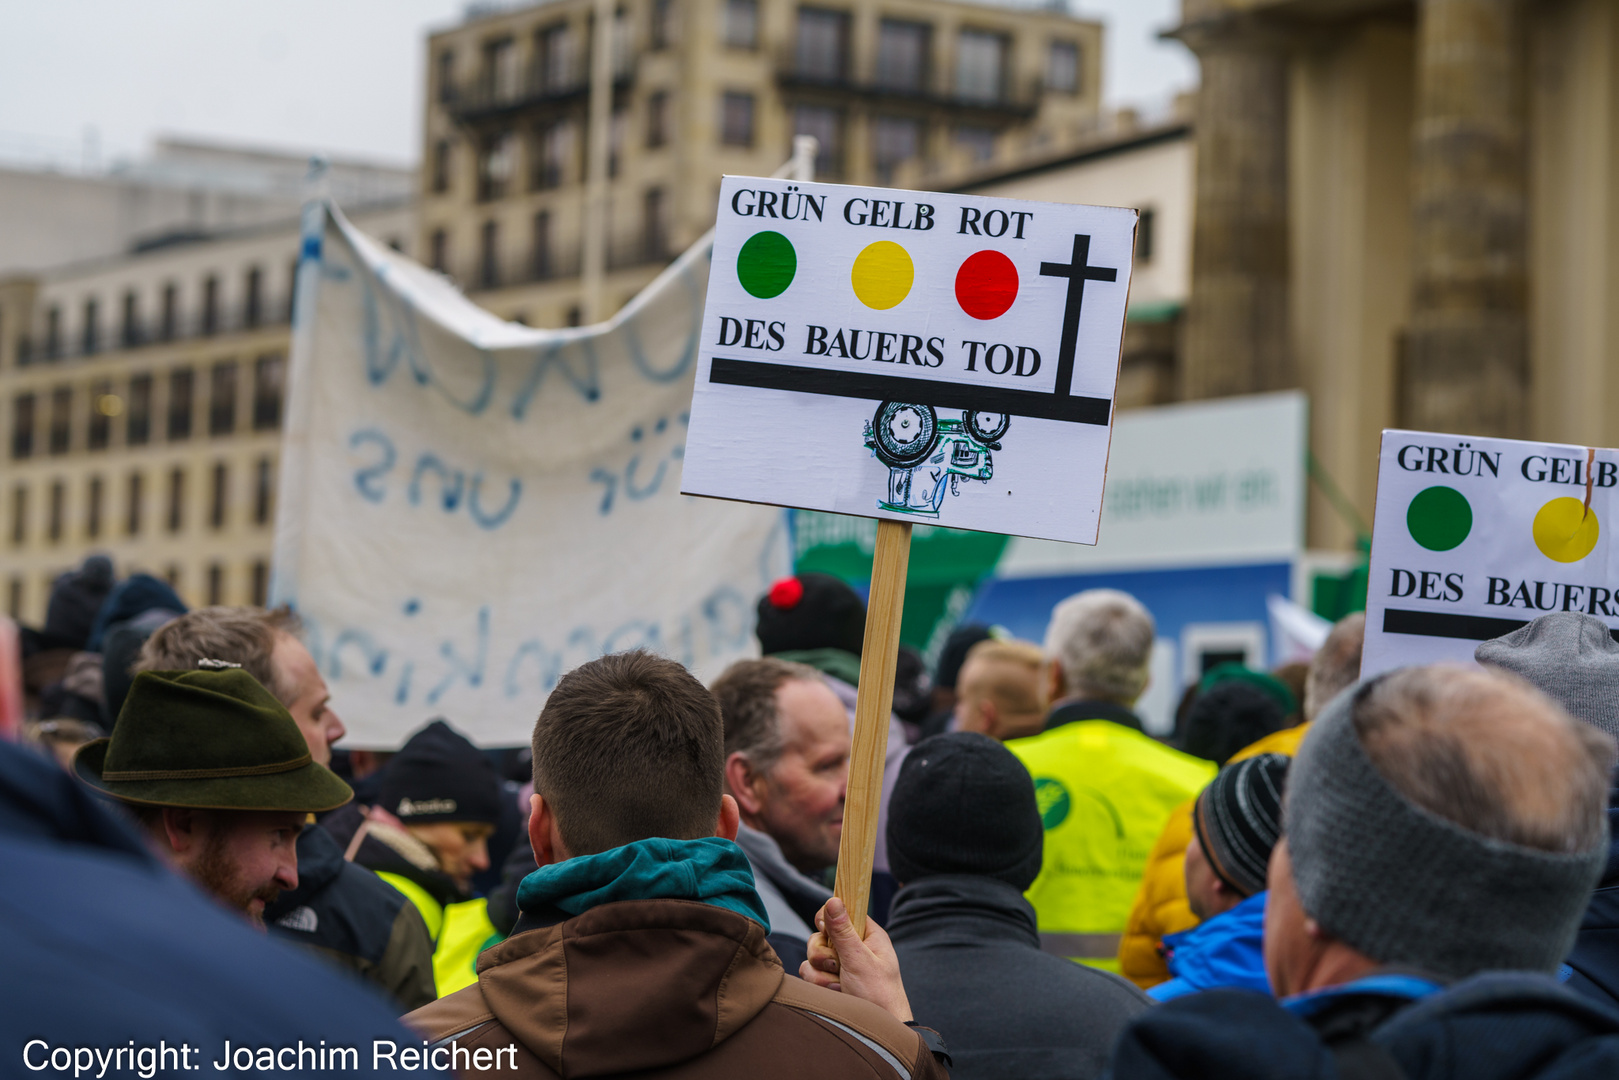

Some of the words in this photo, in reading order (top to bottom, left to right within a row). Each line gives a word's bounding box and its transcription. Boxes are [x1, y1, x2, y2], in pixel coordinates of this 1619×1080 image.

[731, 185, 828, 223] GRÜN
[843, 197, 935, 231] GELB
[956, 206, 1034, 240] ROT
[716, 316, 786, 352] DES
[802, 324, 945, 368] BAUERS
[961, 340, 1042, 377] TOD
[1397, 442, 1502, 478] GRÜN
[1520, 453, 1618, 489] GELB
[1388, 568, 1464, 603] DES
[1484, 576, 1619, 617] BAUER
